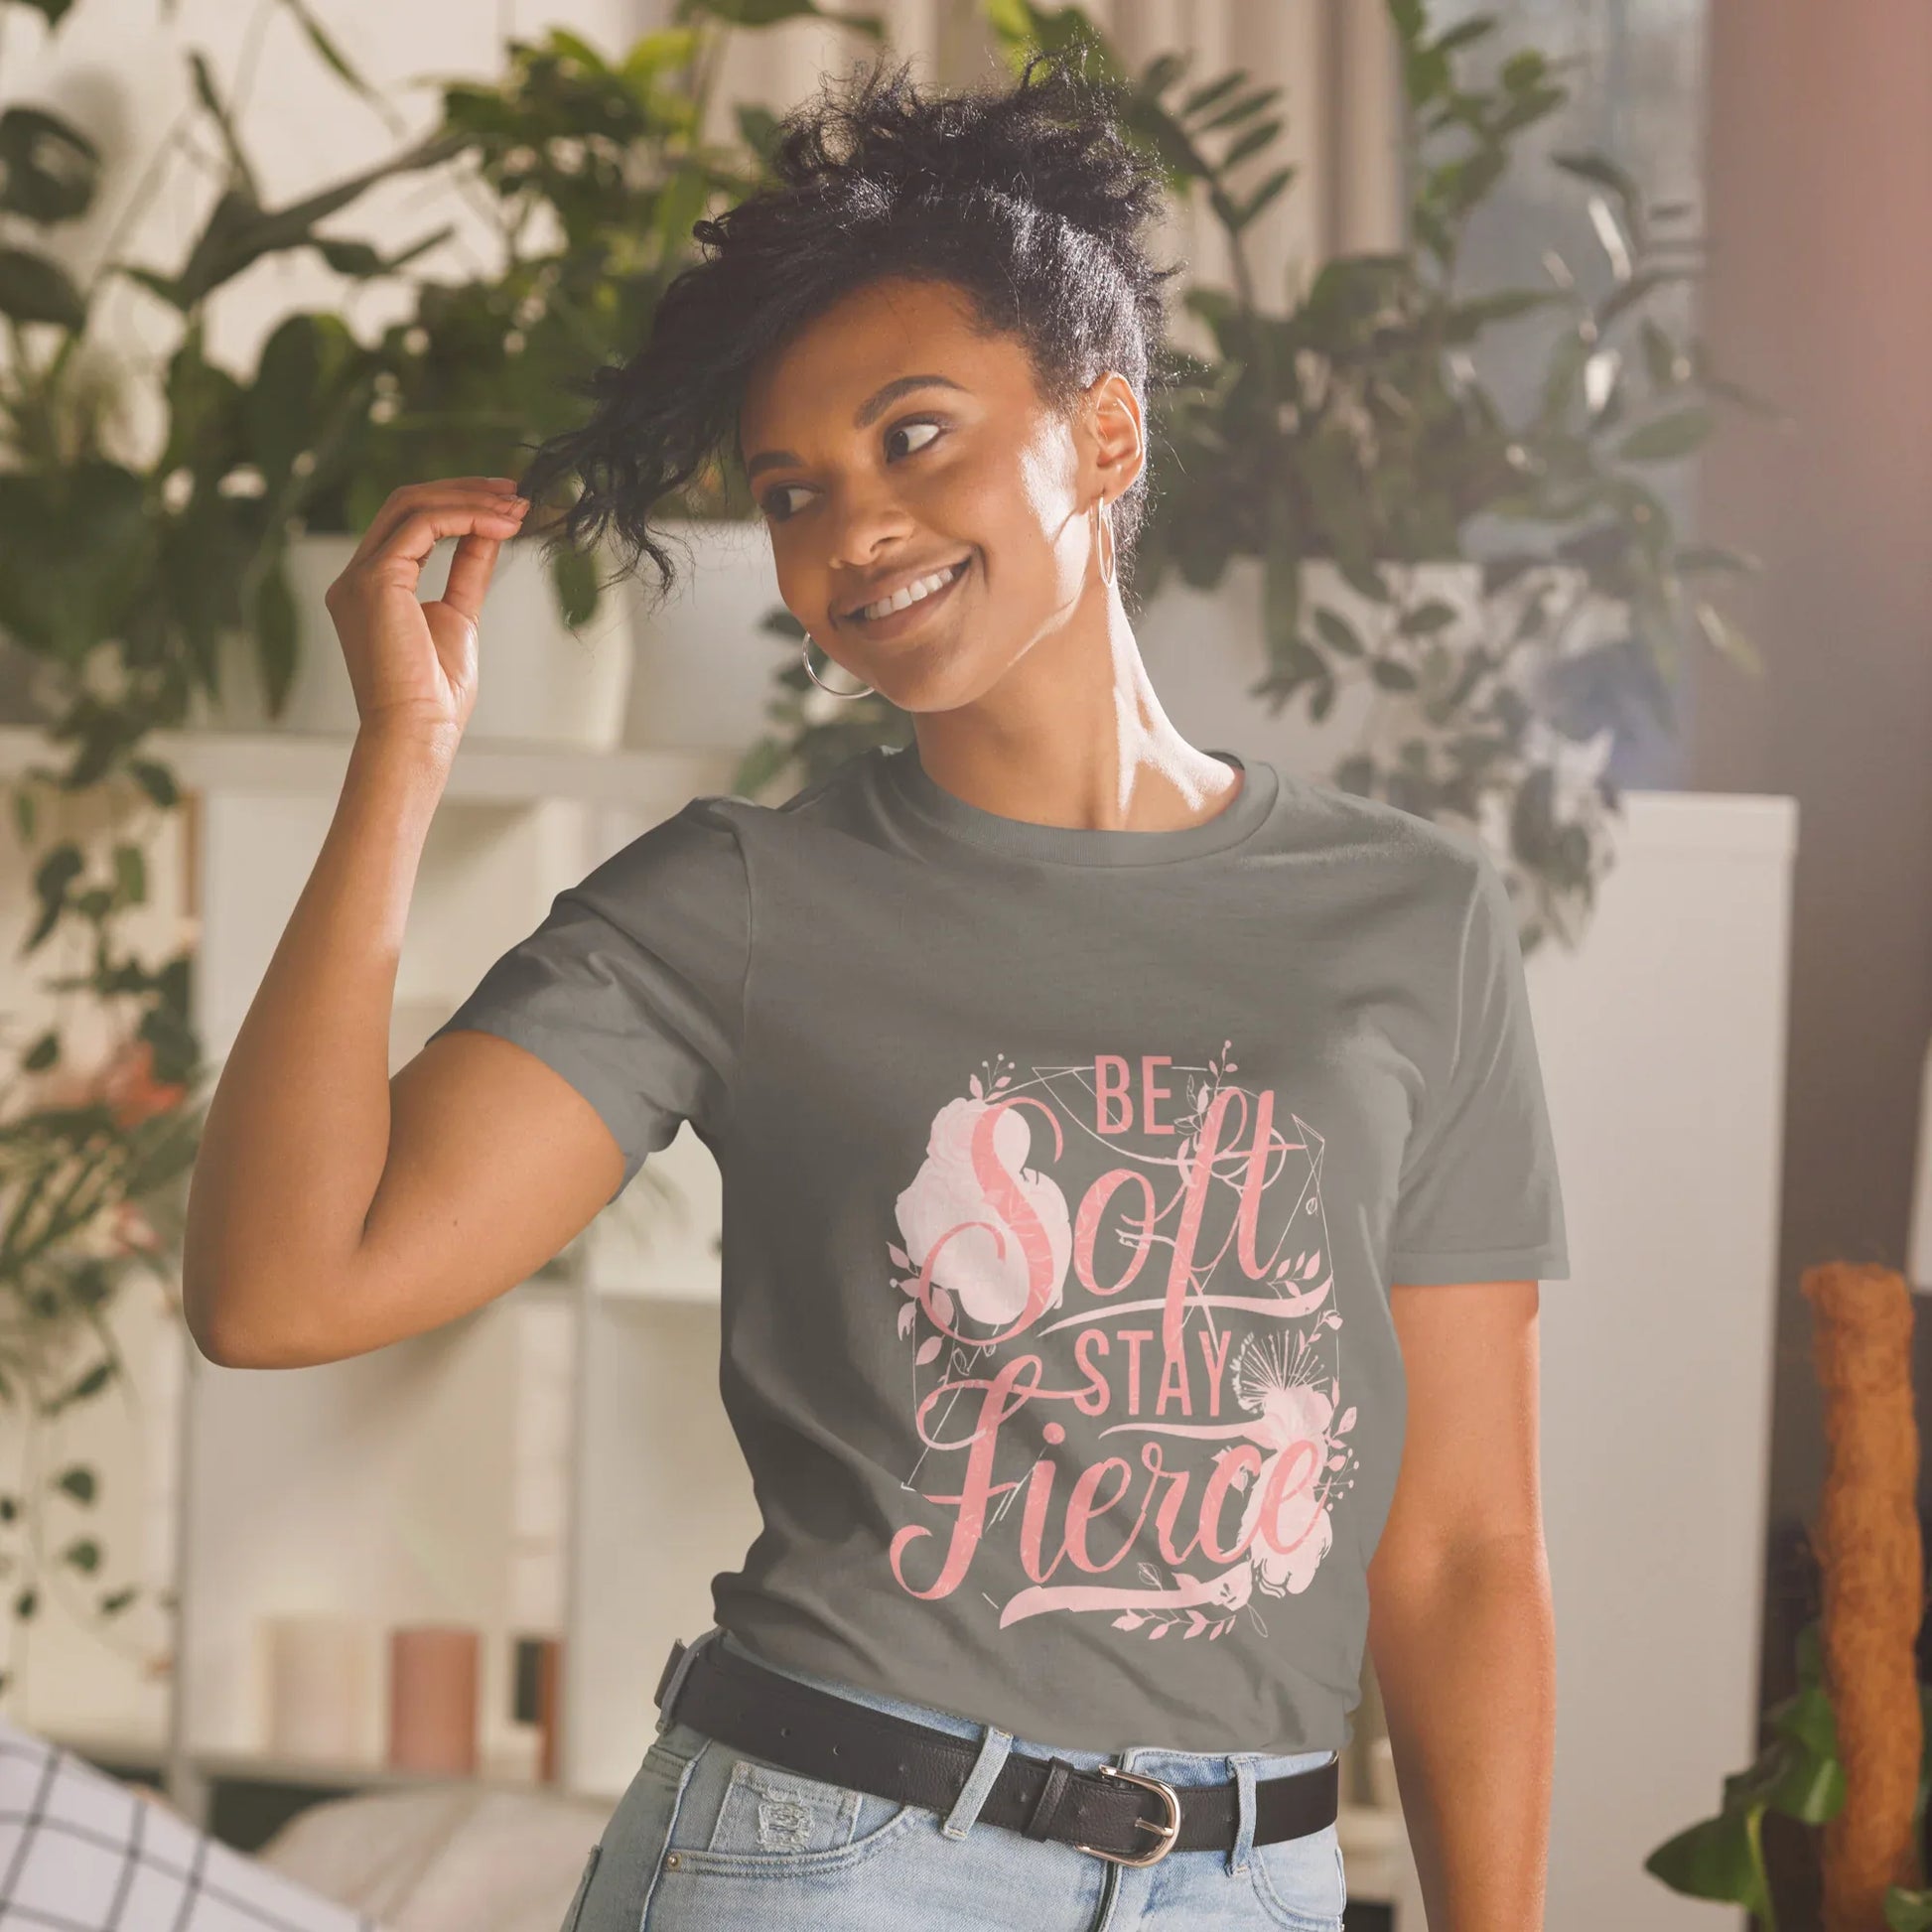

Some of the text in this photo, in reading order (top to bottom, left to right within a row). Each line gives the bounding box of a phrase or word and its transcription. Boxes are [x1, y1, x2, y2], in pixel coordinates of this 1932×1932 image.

[1094, 1053, 1175, 1136] BE
[918, 1086, 1307, 1358] Soft
[1073, 1328, 1232, 1417] STAY
[890, 1354, 1331, 1600] Fierce
